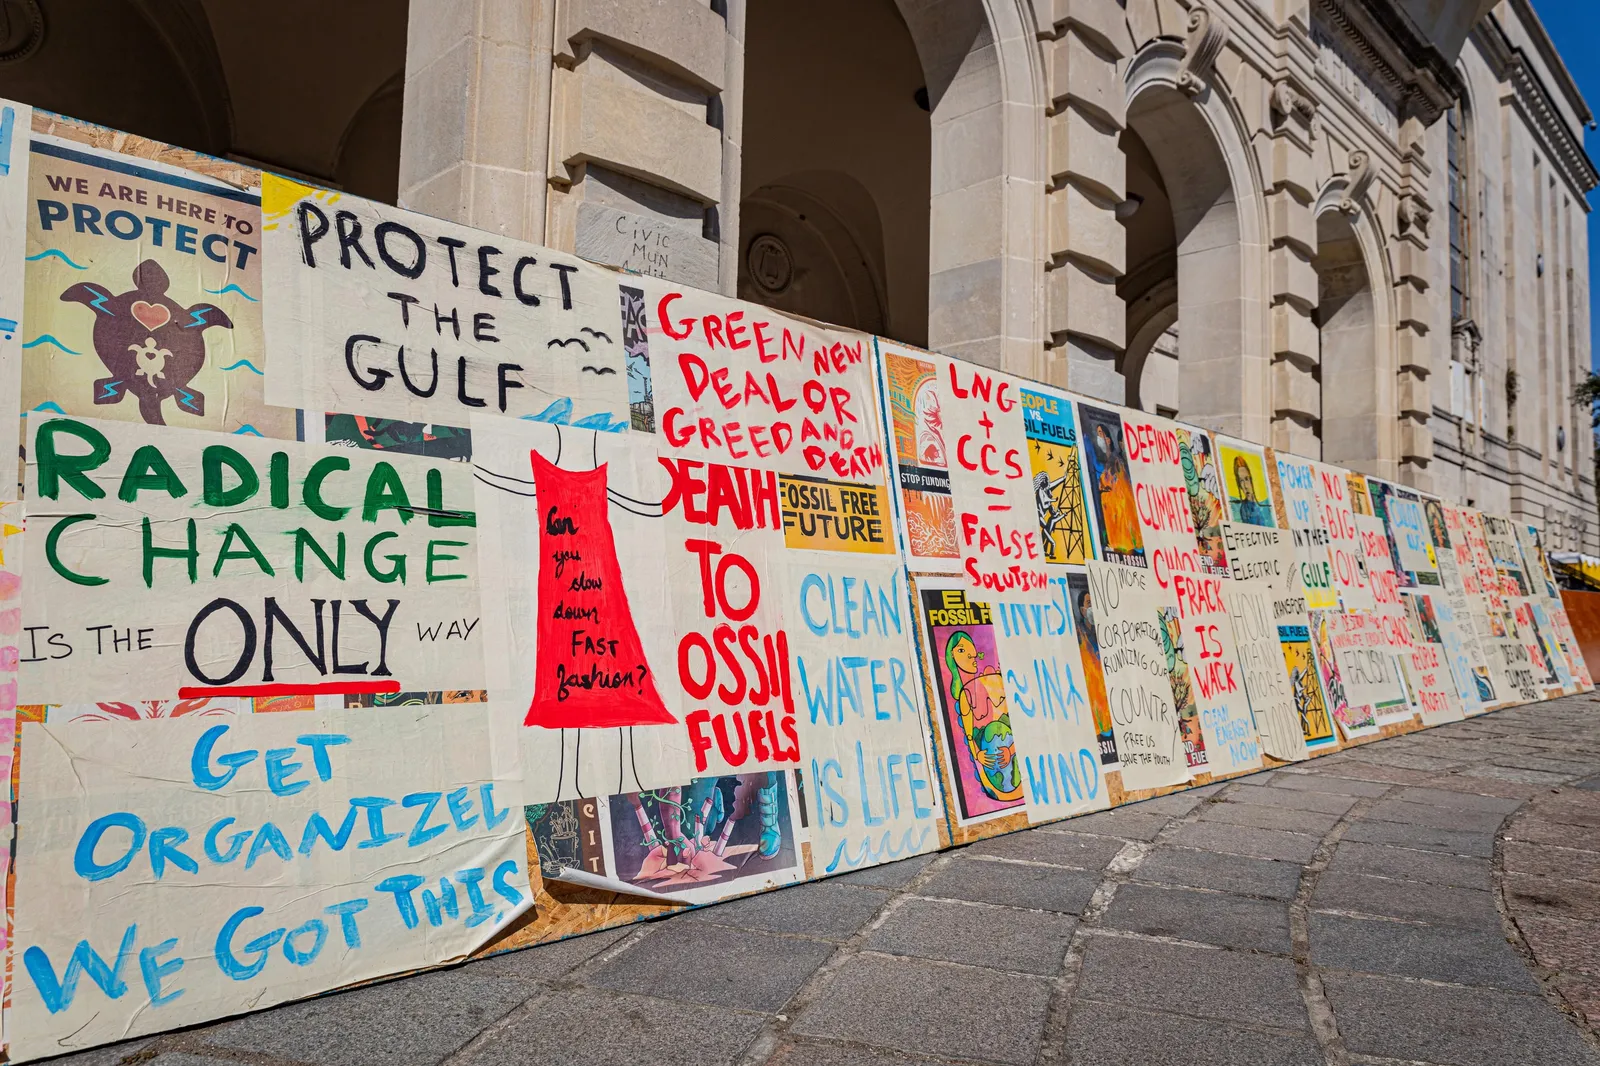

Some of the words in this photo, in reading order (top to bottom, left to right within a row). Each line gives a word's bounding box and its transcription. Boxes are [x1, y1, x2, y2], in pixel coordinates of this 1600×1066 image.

[46, 175, 88, 195] WE
[98, 183, 147, 206] ARE
[157, 194, 215, 224] HERE
[224, 213, 253, 235] TO
[37, 199, 257, 270] PROTECT
[296, 201, 579, 310] PROTECT
[387, 292, 500, 342] THE
[657, 293, 805, 363] GREEN
[813, 340, 862, 376] NEW
[345, 334, 524, 413] GULF
[678, 353, 798, 414] DEAL
[803, 379, 858, 425] OR
[949, 363, 1018, 413] LNG
[1020, 392, 1059, 416] EOPLE
[662, 407, 793, 459] GREED
[801, 417, 854, 450] AND
[1042, 422, 1076, 441] FUELS
[1123, 421, 1181, 465] DEFUND
[36, 418, 477, 528] RADICAL
[802, 443, 882, 479] DEATH
[957, 434, 1023, 480] CCS
[1277, 460, 1313, 490] POWER
[901, 472, 921, 484] STOP
[921, 475, 950, 491] FUNDING
[1321, 471, 1342, 501] NO
[545, 506, 579, 536] Can
[842, 489, 880, 516] FREE
[1136, 482, 1194, 534] CLIMATE
[1293, 499, 1309, 523] UP
[782, 511, 884, 543] FUTURE
[961, 512, 1039, 560] FALSE
[1222, 524, 1279, 551] EFFECTIVE
[1292, 529, 1303, 548] IN
[1325, 504, 1355, 541] BIG
[45, 513, 470, 588] CHANGE
[552, 549, 581, 578] you
[1335, 550, 1364, 588] OIL
[568, 571, 602, 592] slow
[685, 538, 760, 622] TO
[965, 557, 1048, 592] SOLUTION
[1231, 558, 1281, 582] ELECTRIC
[1301, 561, 1330, 588] GULF
[800, 568, 903, 640] CLEAN
[1088, 563, 1120, 617] NO
[1118, 566, 1147, 590] MORE
[1173, 575, 1227, 619] FRACK
[1273, 596, 1306, 620] RANSPORT
[553, 601, 600, 624] down
[929, 609, 980, 626] FOSSIL
[1228, 592, 1270, 641] HOW
[20, 625, 73, 662] IS
[86, 624, 155, 656] THE
[184, 597, 401, 686] ONLY
[417, 617, 480, 642] WAY
[572, 630, 619, 657] FAST
[1194, 624, 1223, 660] IS
[1291, 626, 1309, 638] FUELS
[1103, 648, 1148, 676] RUNNING
[1240, 642, 1279, 671] MANY
[556, 663, 648, 702] fashion?
[797, 655, 916, 727] WATER
[1193, 662, 1238, 700] WACK
[1248, 670, 1285, 702] MORE
[1203, 703, 1230, 729] CLEAN
[686, 709, 800, 772] FUELS
[1123, 731, 1145, 750] FREE
[1145, 734, 1156, 748] US
[1229, 740, 1260, 767] NOW
[191, 724, 352, 797] GET
[1025, 748, 1099, 805] WIND
[1119, 752, 1138, 767] SAVE
[1138, 752, 1152, 765] THE
[1153, 752, 1171, 766] YOUTH
[812, 757, 850, 829] IS
[856, 740, 931, 828] LIFE
[23, 922, 187, 1015] WE
[214, 898, 369, 982] GOT
[375, 859, 525, 930] THIS
